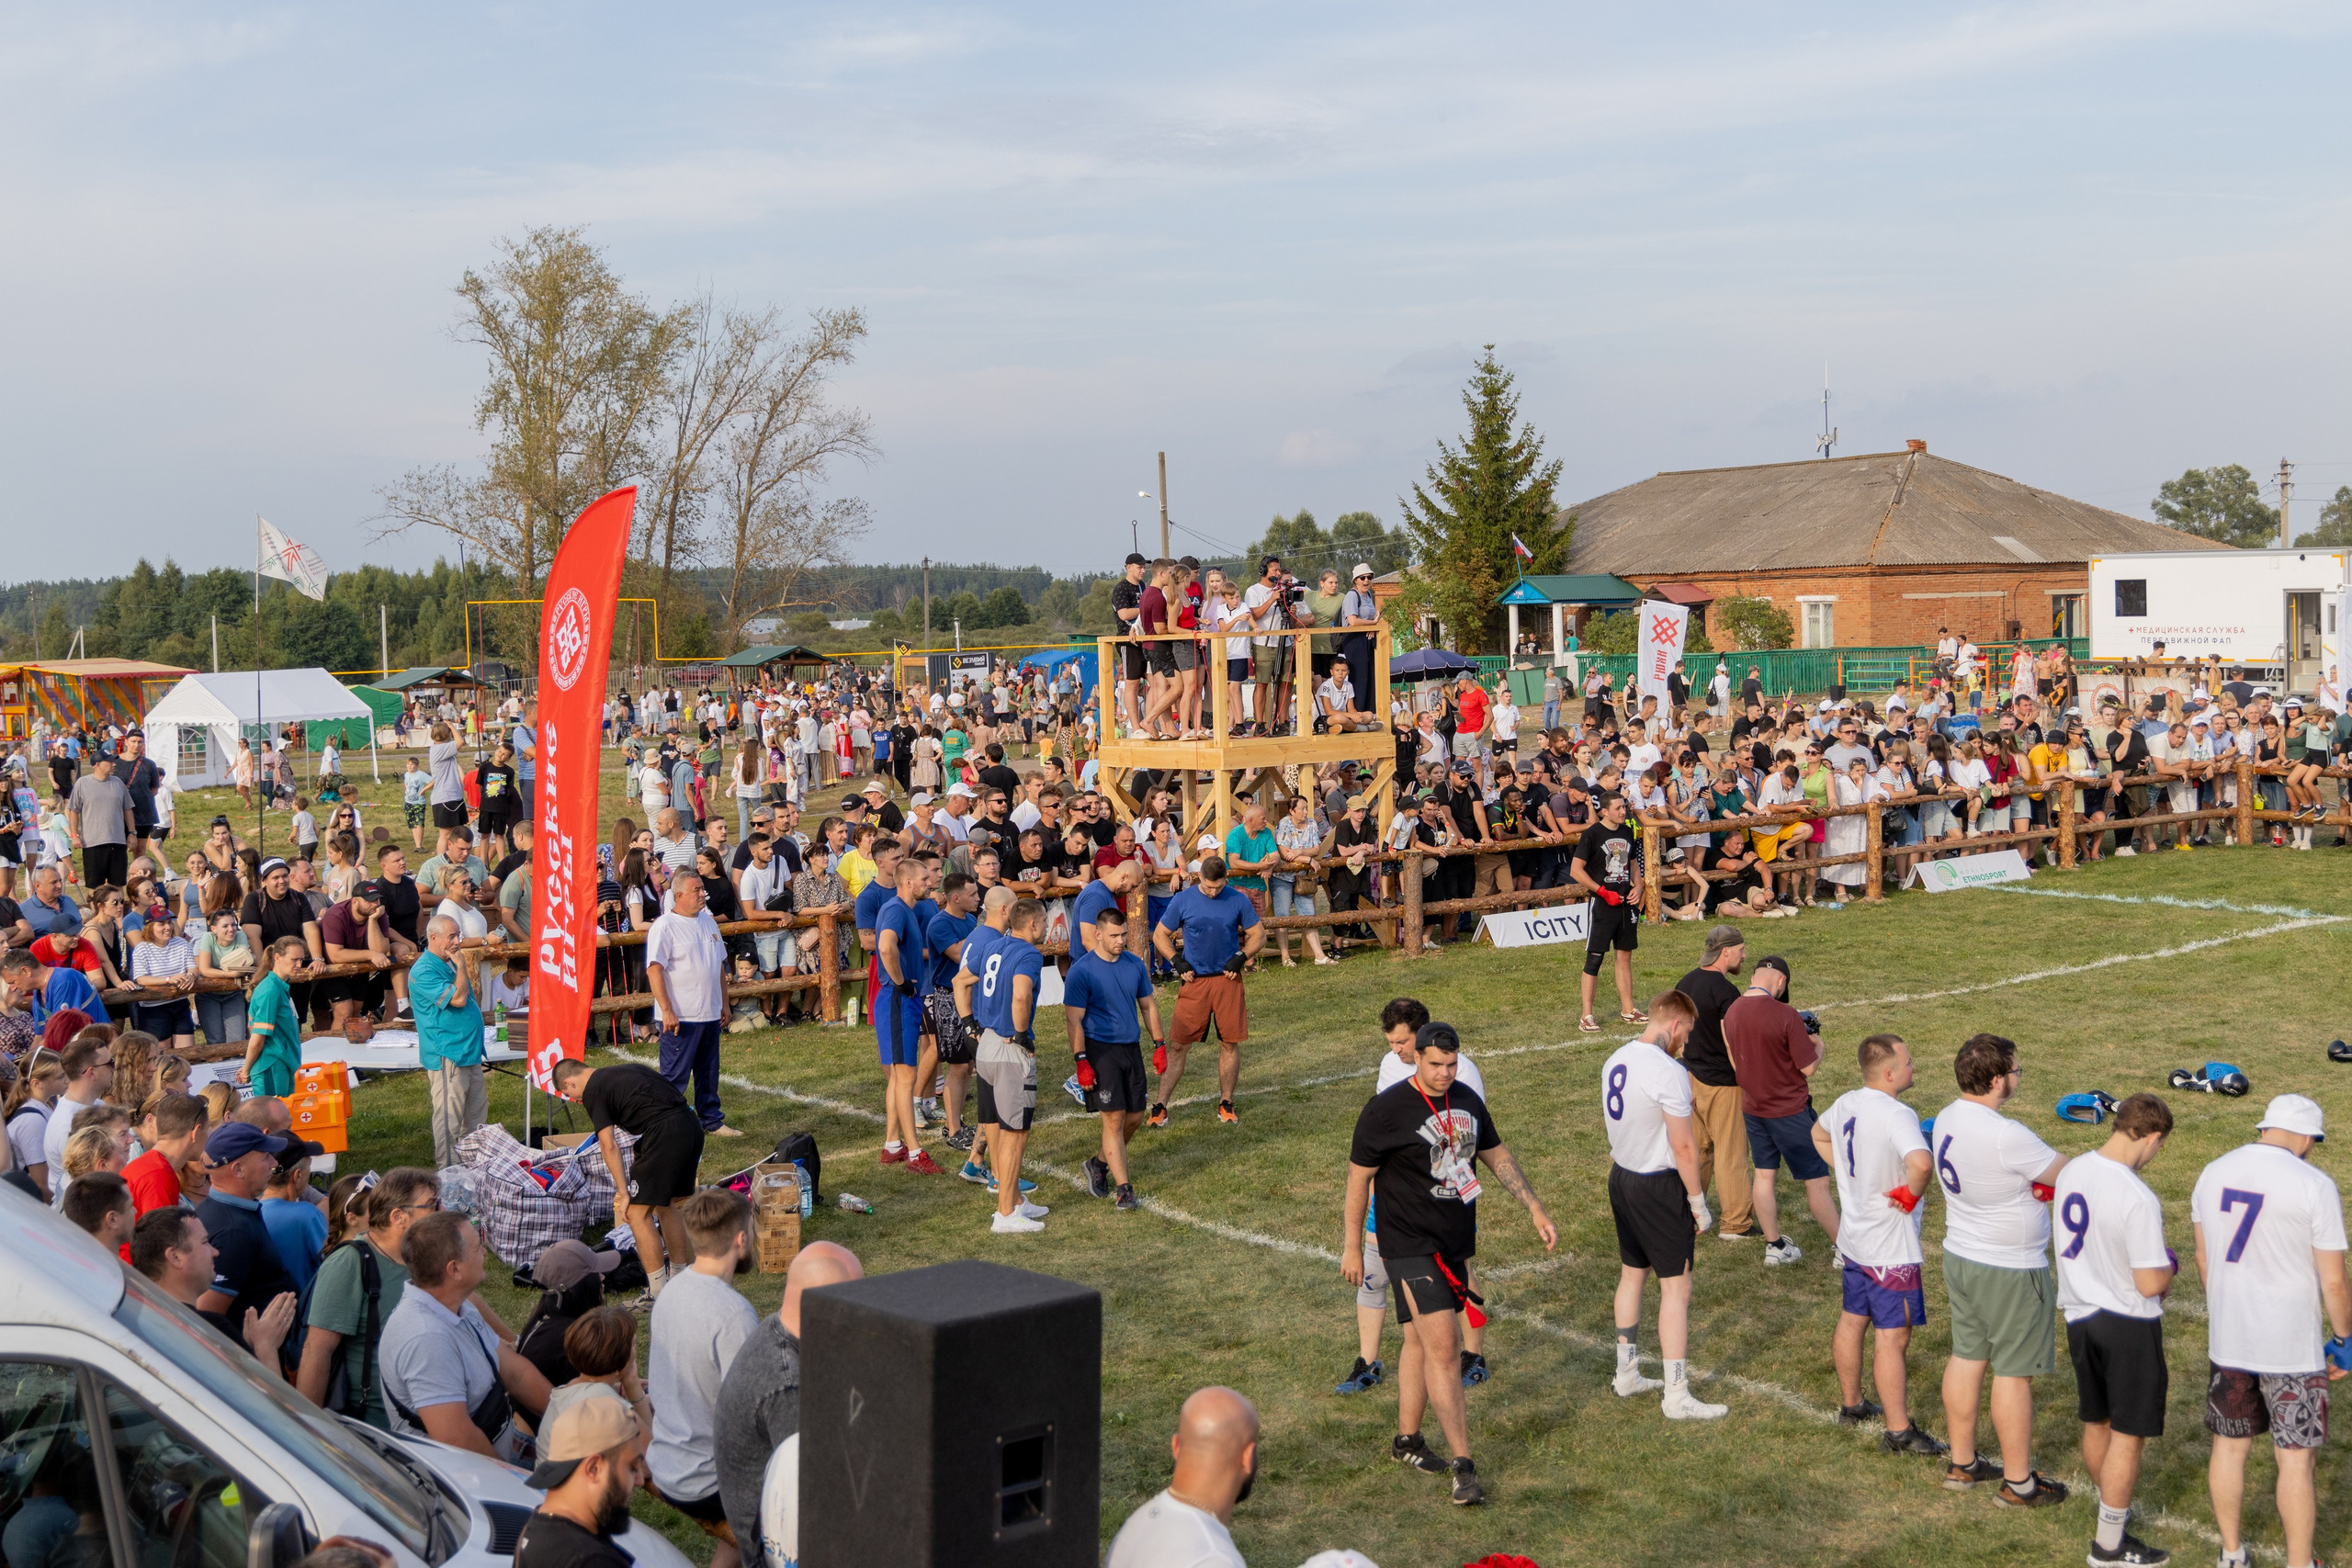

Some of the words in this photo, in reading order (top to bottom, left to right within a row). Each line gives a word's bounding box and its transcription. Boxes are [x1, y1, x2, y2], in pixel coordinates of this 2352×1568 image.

[2136, 626, 2203, 635] МЕДИЦИНСКАЯ
[962, 655, 985, 664] ВЕЗУВИЙ
[1654, 649, 1668, 682] РЮХИ
[540, 720, 564, 981] РУССКИЕ
[1960, 866, 1984, 875] WORLD
[1962, 870, 2007, 884] ETHNOSPORT
[560, 829, 579, 993] ИГРЫ
[1523, 914, 1582, 941] ICITY
[983, 953, 1002, 998] 8
[1606, 1064, 1627, 1121] 8
[1843, 1116, 1856, 1178] 1
[1937, 1134, 1961, 1195] 6
[2061, 1192, 2090, 1259] 9
[2220, 1188, 2265, 1263] 7
